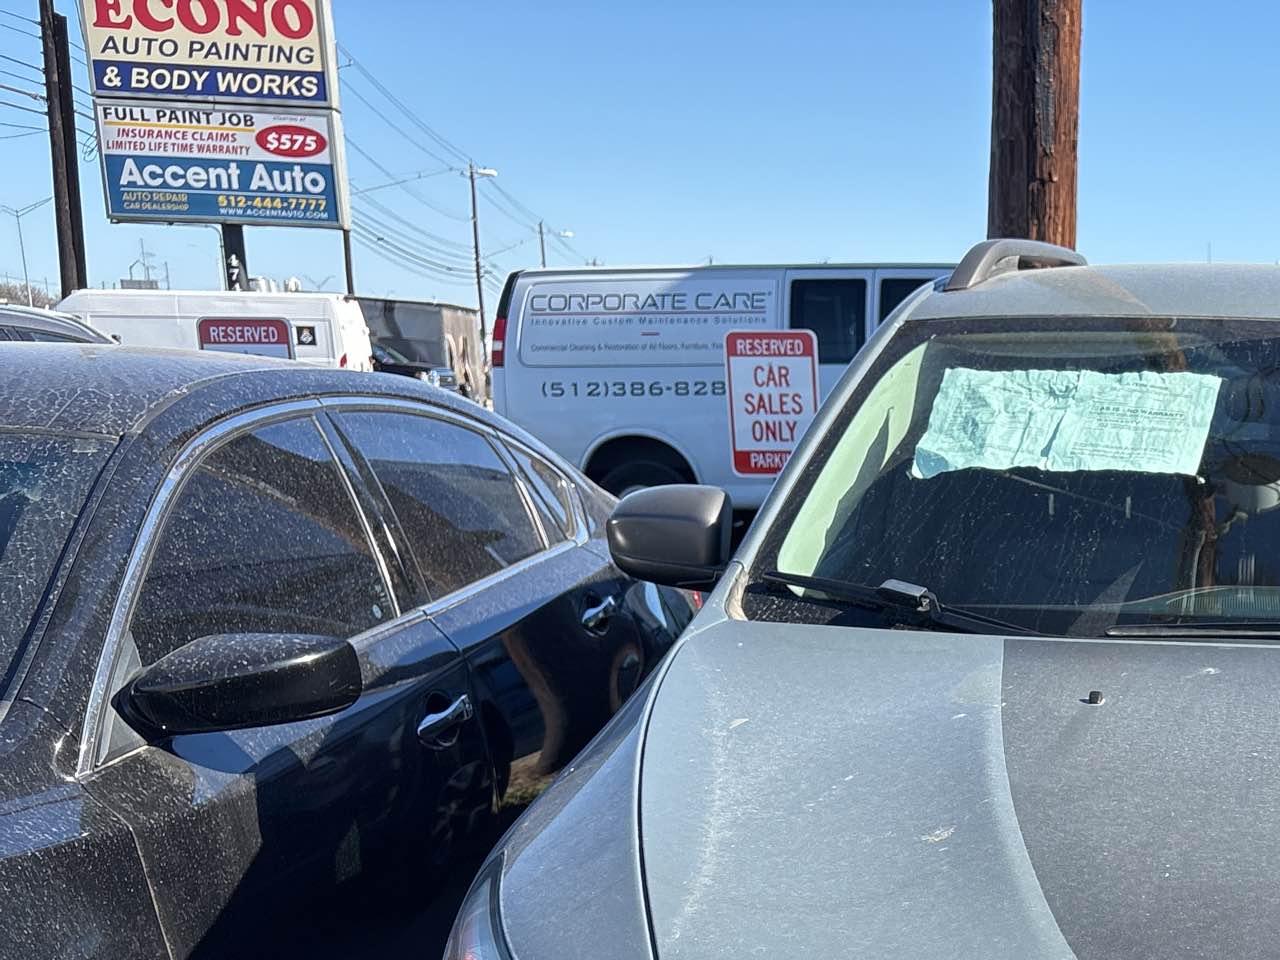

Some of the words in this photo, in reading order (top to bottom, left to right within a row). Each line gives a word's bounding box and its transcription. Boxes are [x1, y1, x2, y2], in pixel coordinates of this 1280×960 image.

[93, 0, 314, 40] ECONO
[100, 35, 179, 57] AUTO
[188, 40, 315, 65] PAINTING
[103, 66, 122, 87] &
[131, 67, 210, 91] BODY
[217, 71, 319, 98] WORKS
[102, 107, 151, 122] FULL
[156, 109, 213, 125] PAINT
[219, 112, 255, 128] JOB
[117, 127, 188, 141] INSURANCE
[191, 131, 237, 143] CLAIMS
[266, 131, 317, 152] $575
[106, 140, 146, 151] LIMITED
[148, 142, 169, 152] LIFE
[171, 143, 194, 153] TIME
[196, 144, 251, 156] WARRANTY
[120, 158, 240, 191] Accent
[250, 163, 326, 194] Auto
[122, 192, 151, 202] AUTO
[152, 192, 188, 203] REPAIR
[219, 208, 328, 220] WWW.ACCENTAUTO.COM
[530, 293, 687, 311] CORPORATE
[695, 292, 767, 309] CARE
[593, 317, 634, 325] Custom
[639, 316, 708, 324] Maintenance
[714, 316, 767, 324] Solutions
[209, 326, 278, 343] RESERVED
[736, 339, 803, 354] RESERVED
[754, 365, 790, 387] CAR
[542, 381, 726, 397] (512)386-828
[744, 393, 803, 415] SALES
[752, 420, 797, 442] ONLY
[751, 453, 792, 468] PARKI
